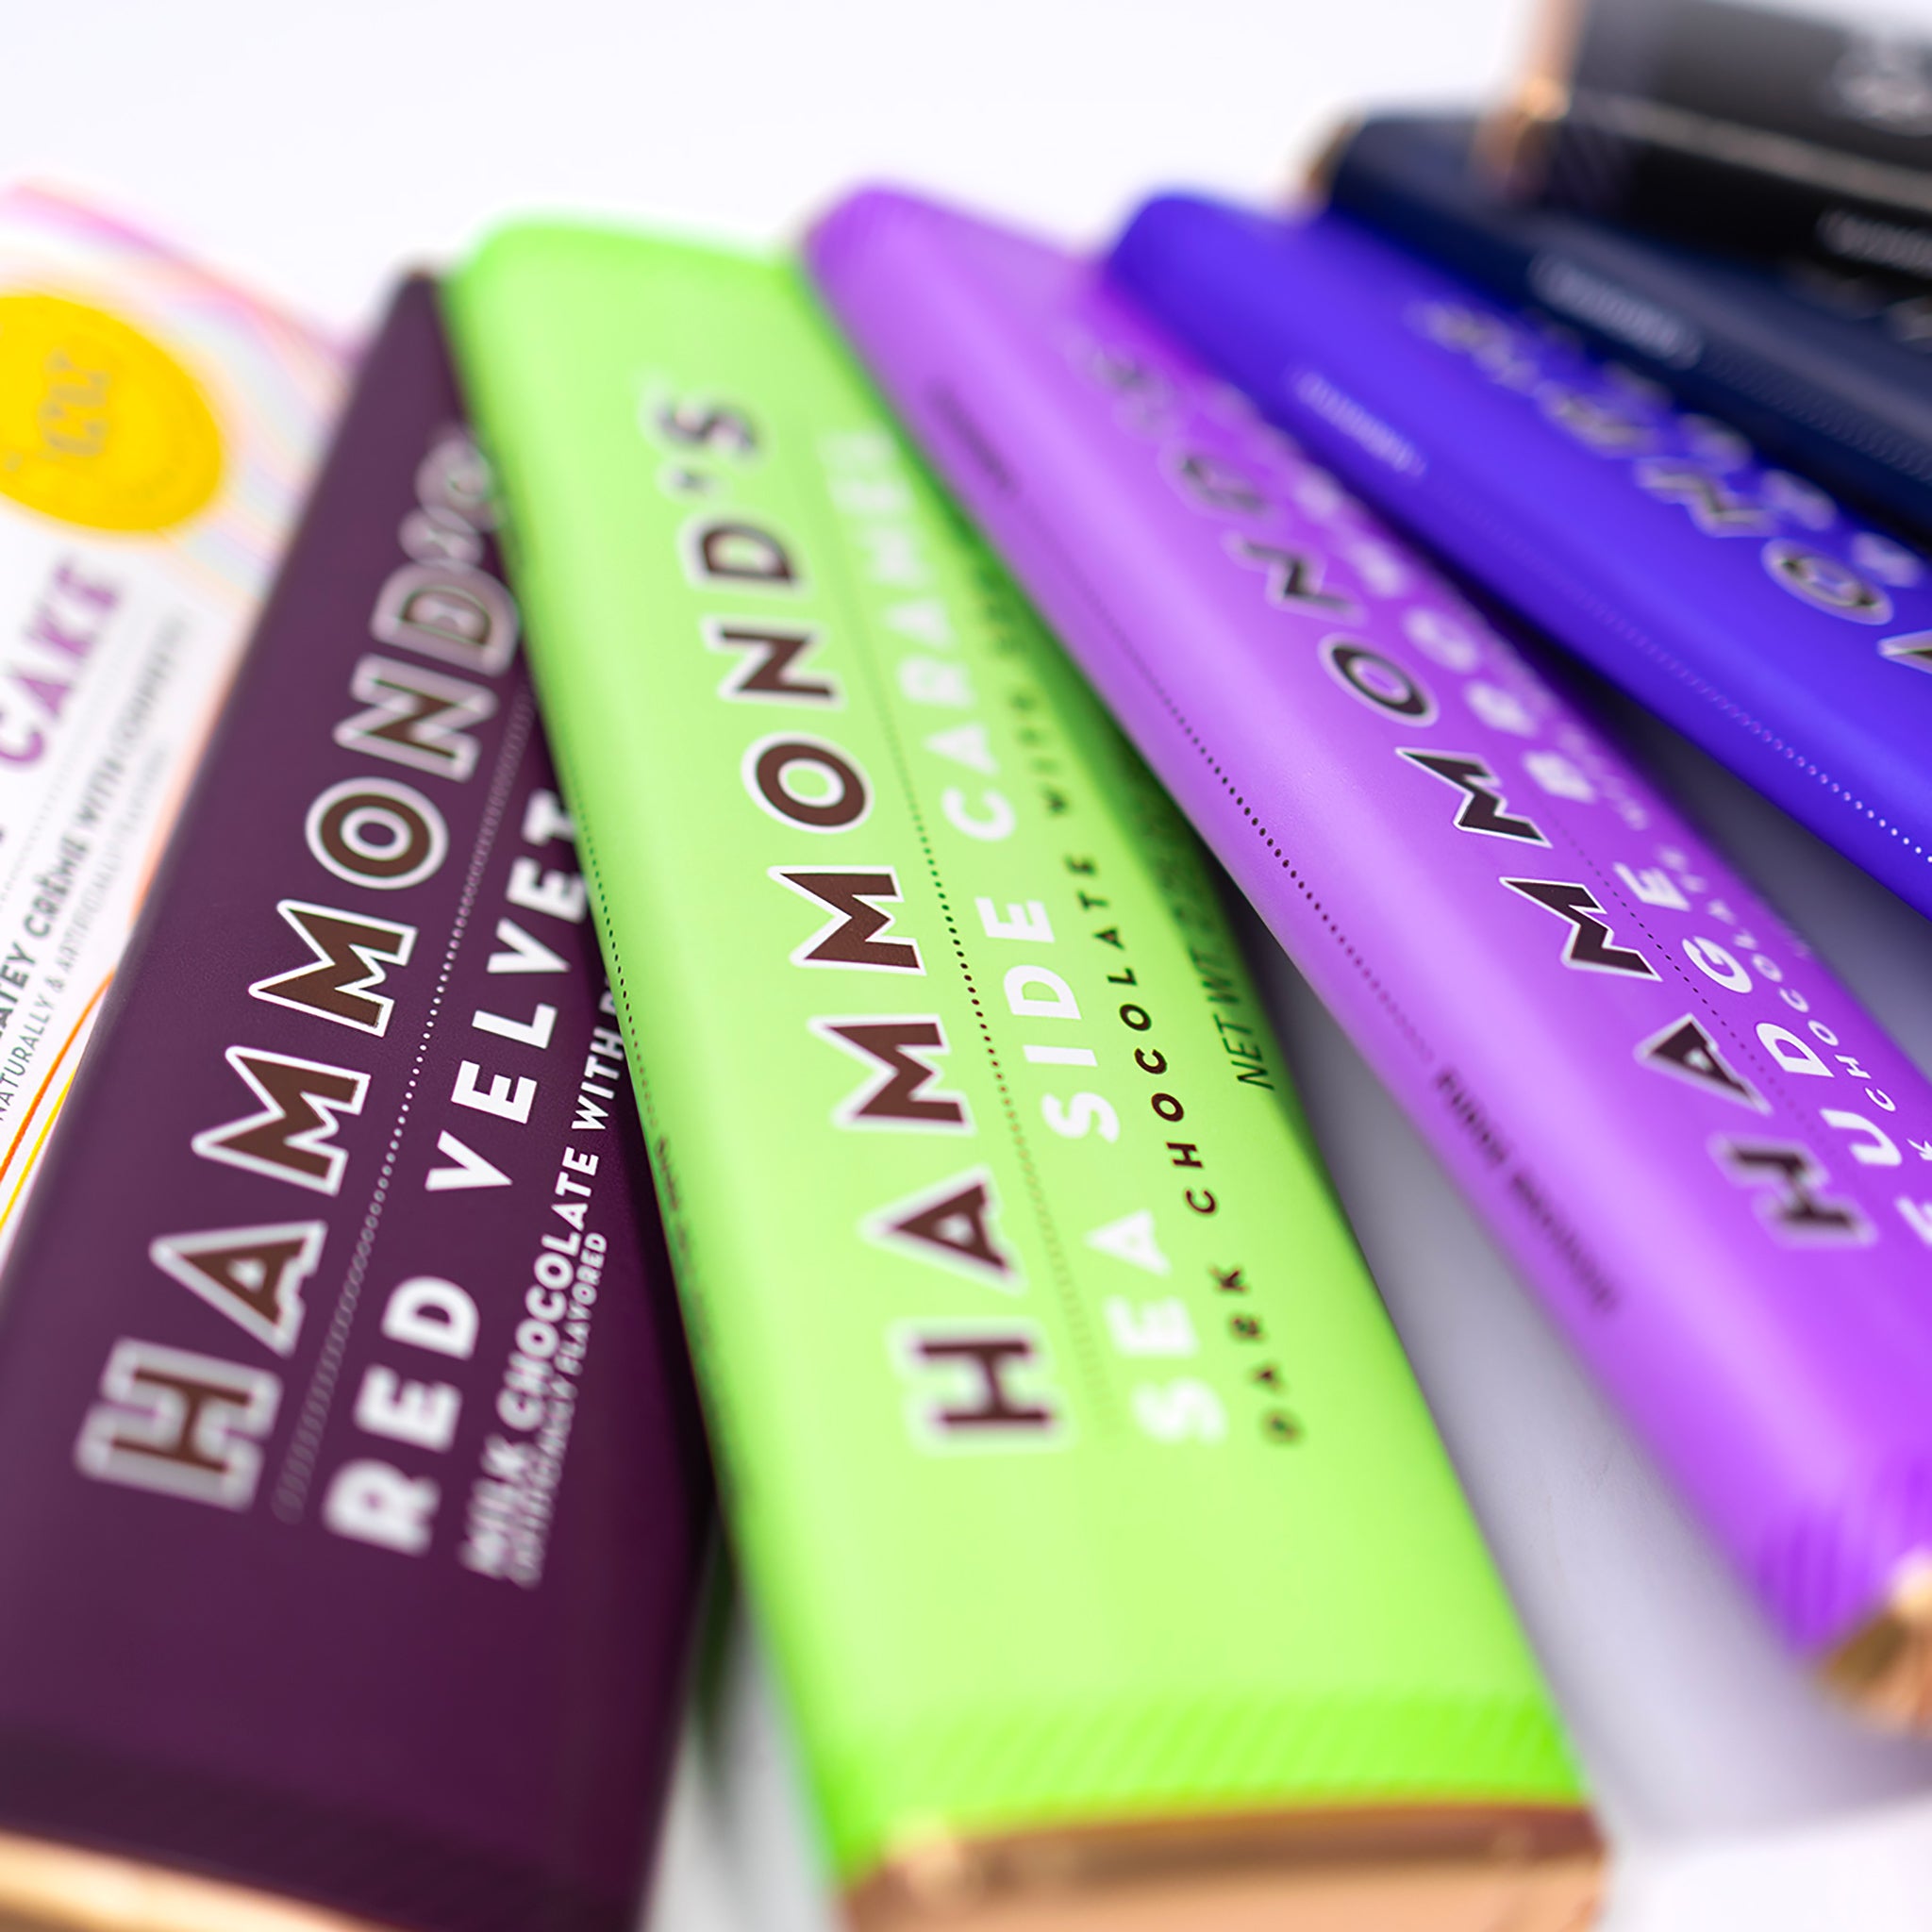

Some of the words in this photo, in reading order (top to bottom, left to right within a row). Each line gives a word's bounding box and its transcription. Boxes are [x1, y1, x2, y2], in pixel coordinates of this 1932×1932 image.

[643, 374, 1070, 1454] HAMMOND'S
[974, 896, 1120, 1142] SIDE
[1065, 853, 1219, 1216] CHOCOLATE
[1213, 1012, 1274, 1091] NET
[322, 1274, 479, 1557] RED
[425, 789, 588, 1191] VELVET
[497, 1147, 602, 1430] CHOCOLATE
[572, 1026, 625, 1130] WITH
[1086, 1209, 1226, 1441] SEA
[1208, 1265, 1303, 1445] DARK
